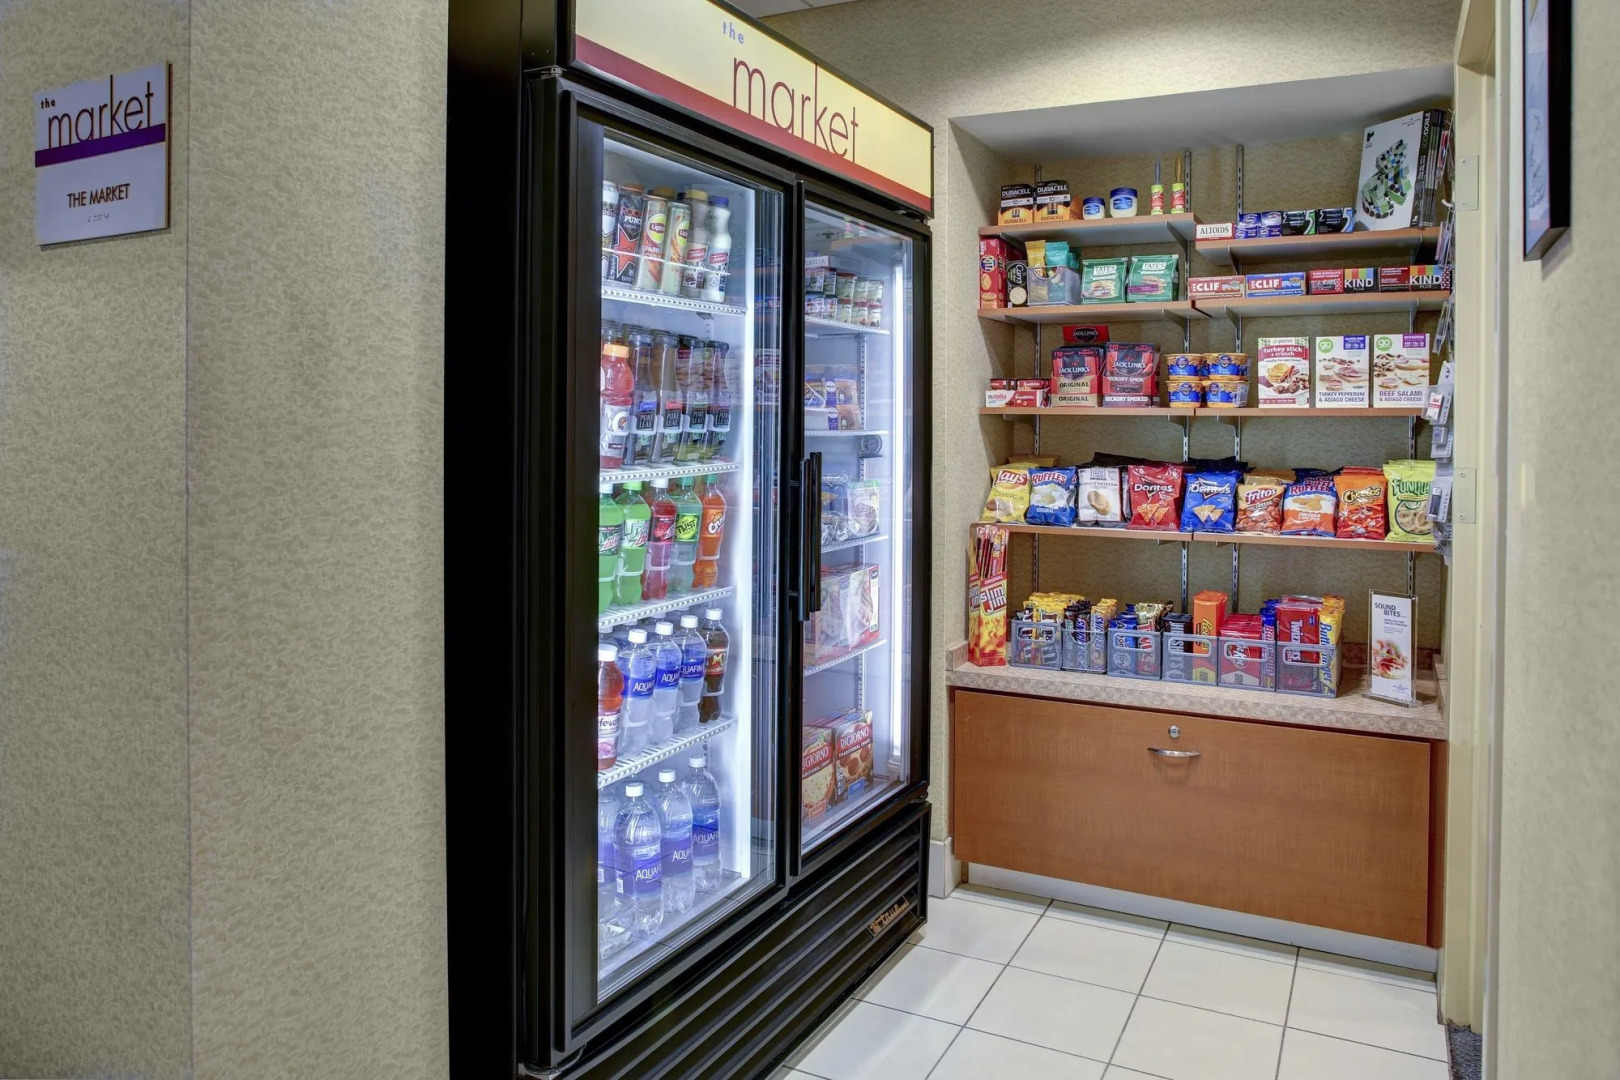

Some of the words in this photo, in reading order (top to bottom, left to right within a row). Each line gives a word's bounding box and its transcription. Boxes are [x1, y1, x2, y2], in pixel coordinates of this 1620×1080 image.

[722, 21, 745, 45] the
[41, 98, 56, 109] the
[49, 75, 155, 149] market
[733, 57, 859, 163] market
[1001, 188, 1031, 198] DURACELL
[1037, 184, 1068, 195] DURACELL
[67, 191, 87, 209] THE
[89, 183, 131, 206] MARKET
[1199, 226, 1229, 236] ALTOIDS
[1255, 279, 1279, 288] CLIF
[1344, 278, 1374, 288] KIND
[1410, 275, 1442, 285] KIND
[1197, 282, 1219, 292] CLIF
[1263, 347, 1286, 355] turkey
[1113, 361, 1127, 369] JACK
[1059, 367, 1072, 375] JACK
[1059, 381, 1089, 389] ORIGINAL
[1058, 395, 1089, 403] ORIGINAL
[640, 414, 654, 422] PURE
[994, 470, 1027, 485] Lay's
[1032, 471, 1067, 486] RUFFLES
[1134, 483, 1174, 493] Doritos
[1190, 483, 1231, 495] Doritos
[1244, 488, 1277, 505] Fritos
[1343, 486, 1381, 504] Cheetos
[1374, 602, 1396, 611] SOUND
[838, 743, 861, 758] TRADITIONAL
[861, 739, 871, 750] CRUST
